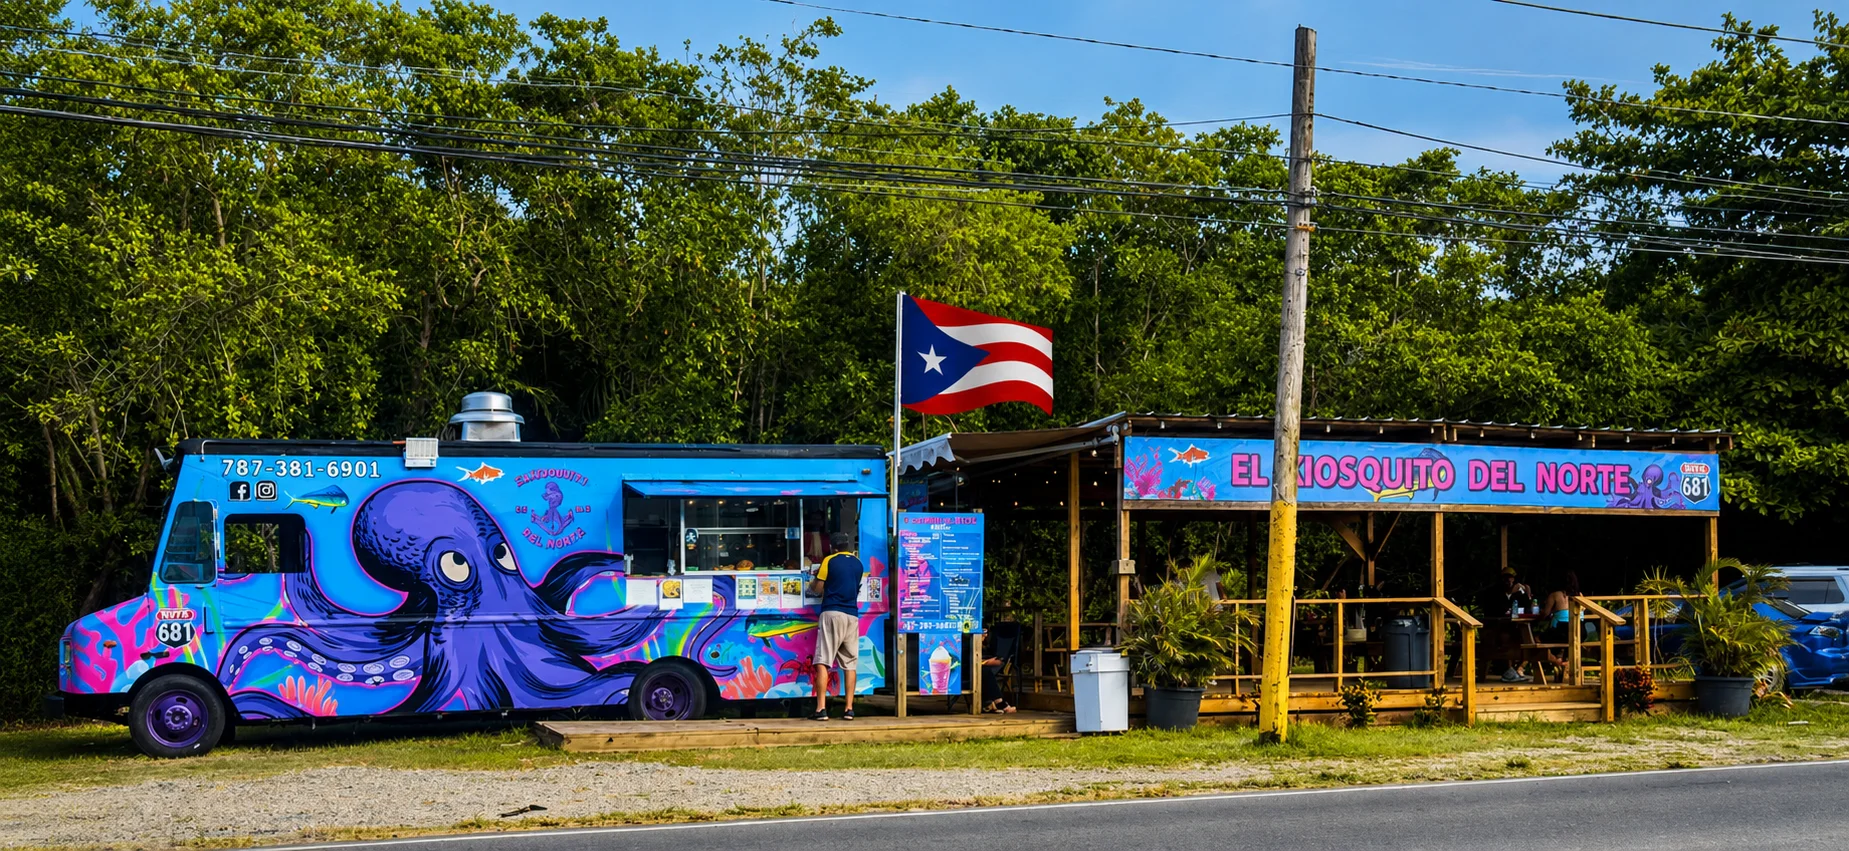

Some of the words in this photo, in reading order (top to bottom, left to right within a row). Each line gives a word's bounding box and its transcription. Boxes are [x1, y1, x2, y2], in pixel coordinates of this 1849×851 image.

[222, 459, 381, 478] 787-381-6901
[1231, 453, 1269, 488] EL
[1468, 459, 1525, 492] DEL
[1536, 461, 1632, 495] NORTE
[1682, 477, 1708, 497] 681
[158, 622, 191, 642] 681
